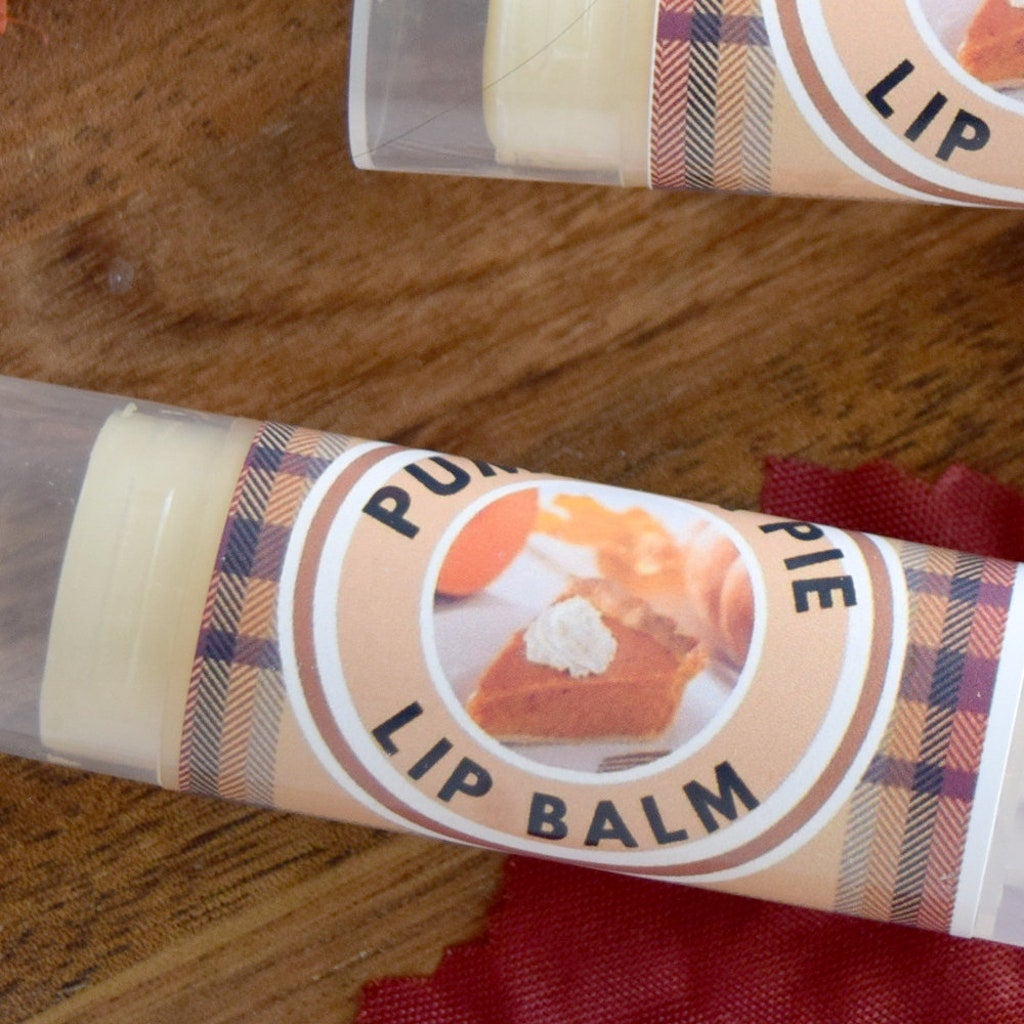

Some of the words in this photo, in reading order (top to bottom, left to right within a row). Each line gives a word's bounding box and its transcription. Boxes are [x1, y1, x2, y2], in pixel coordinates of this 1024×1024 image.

[865, 59, 991, 162] LIP
[758, 521, 858, 613] PIE
[371, 701, 494, 803] LIP
[526, 760, 761, 849] BALM
